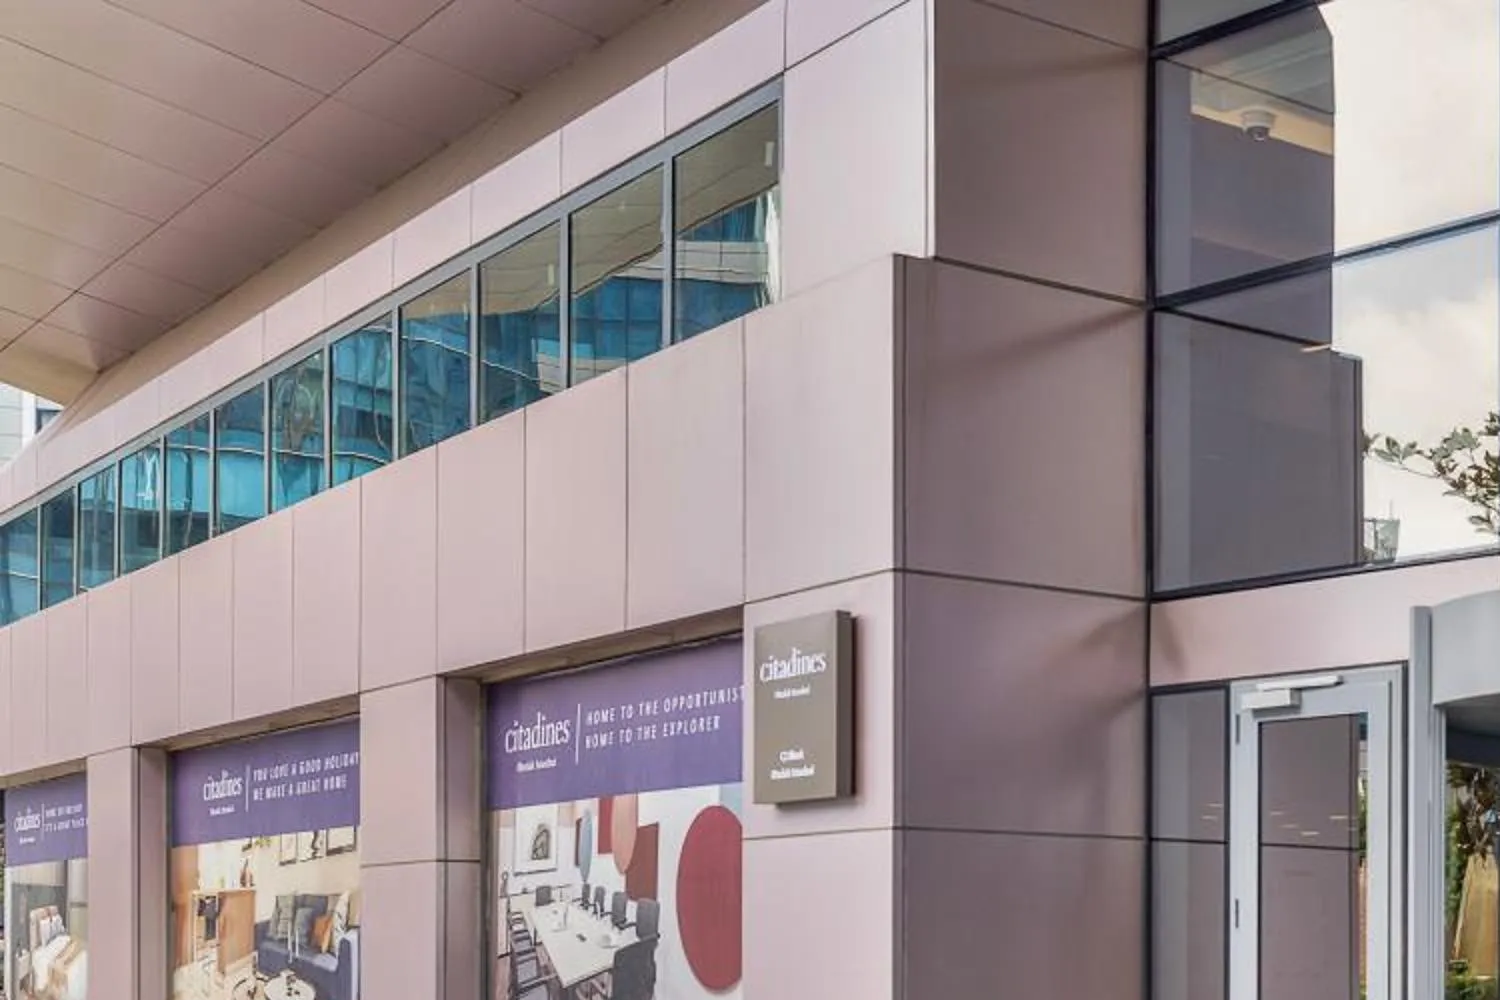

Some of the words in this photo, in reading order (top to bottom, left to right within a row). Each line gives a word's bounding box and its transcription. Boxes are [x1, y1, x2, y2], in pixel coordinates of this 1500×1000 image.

[760, 647, 827, 682] citadines
[585, 707, 616, 726] HOME
[620, 704, 634, 720] TO
[638, 700, 659, 717] THE
[505, 711, 571, 753] citadines
[585, 731, 614, 749] HOME
[619, 727, 633, 743] TO
[637, 724, 657, 741] THE
[663, 715, 721, 737] EXPLORER
[203, 769, 243, 801] citadines
